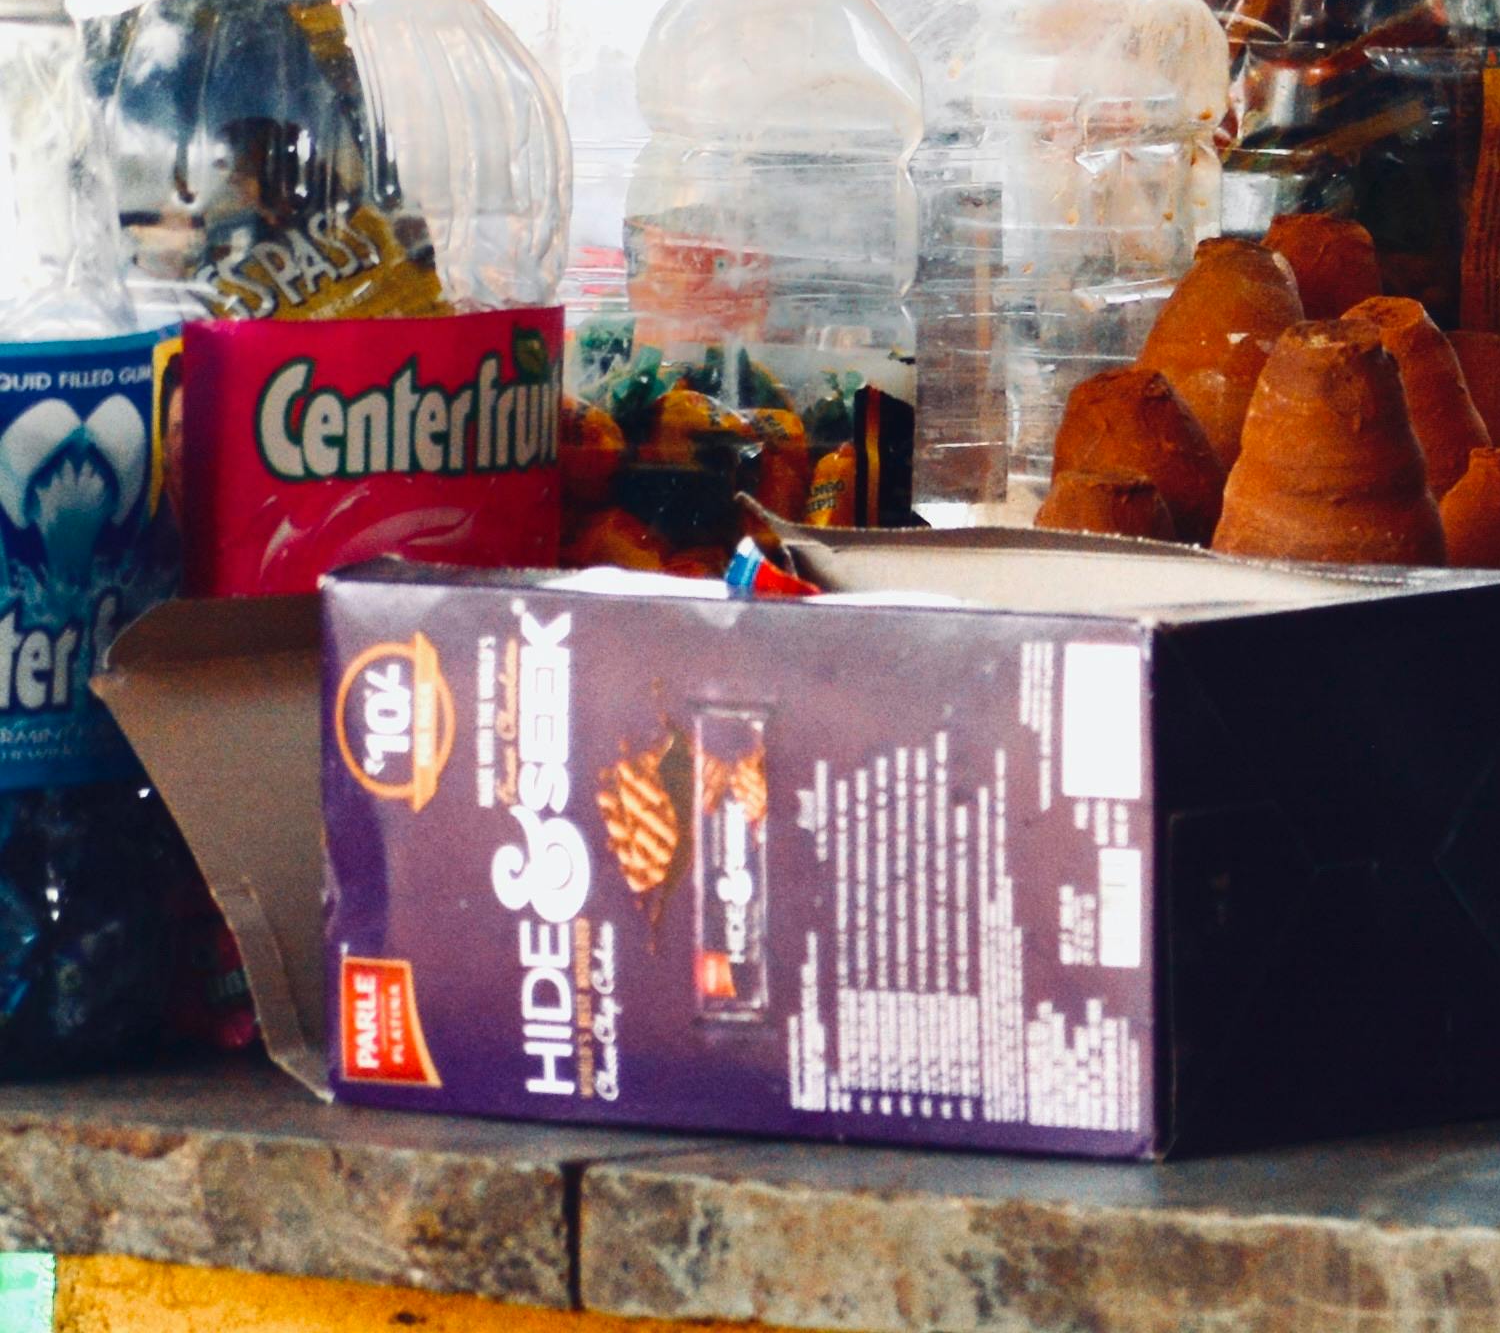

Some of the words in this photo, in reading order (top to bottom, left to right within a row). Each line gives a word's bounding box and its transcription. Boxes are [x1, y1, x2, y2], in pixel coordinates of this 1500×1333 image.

[57, 368, 115, 390] FILLED
[118, 363, 153, 386] GUM
[518, 611, 572, 814] SEEK
[490, 803, 592, 923] &
[354, 974, 381, 1070] PARLE
[388, 983, 406, 1065] PLATINA
[518, 919, 576, 1096] HIDE
